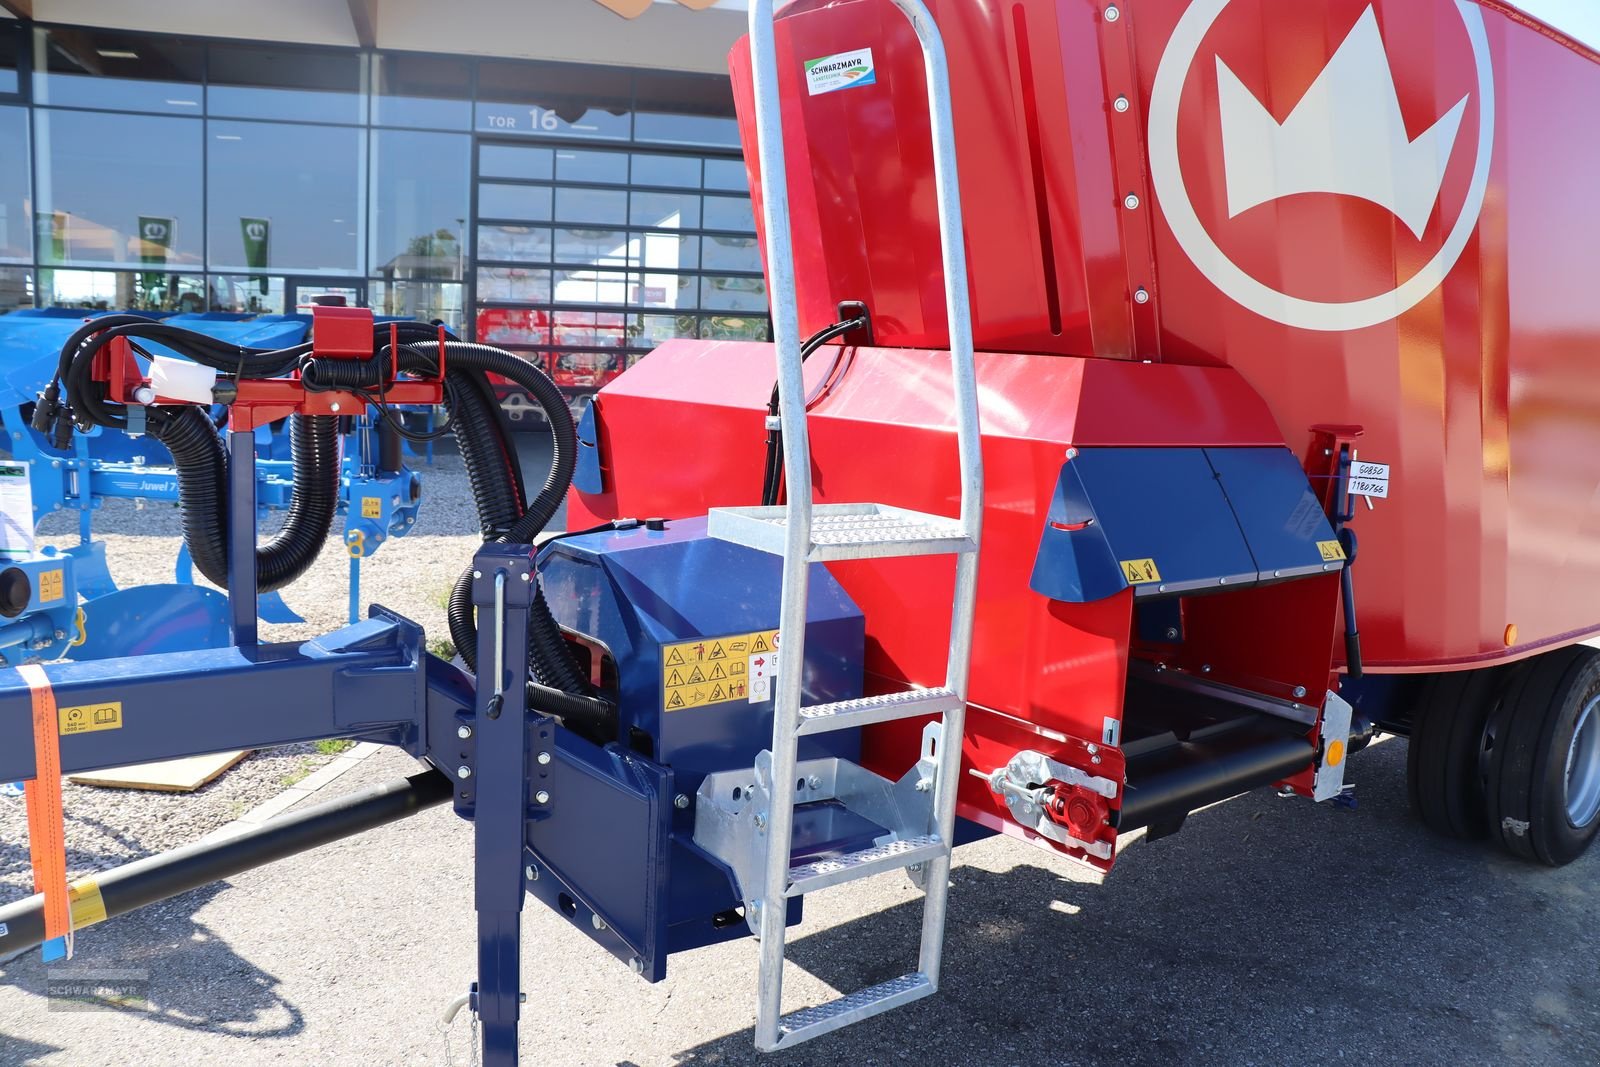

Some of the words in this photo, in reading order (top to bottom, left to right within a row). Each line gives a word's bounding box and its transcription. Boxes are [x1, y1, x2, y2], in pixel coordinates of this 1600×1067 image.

[811, 58, 862, 76] SCHWARZMAYR
[487, 115, 516, 128] TOR
[529, 108, 558, 131] 16
[139, 480, 168, 492] Juwel
[169, 482, 177, 492] 7
